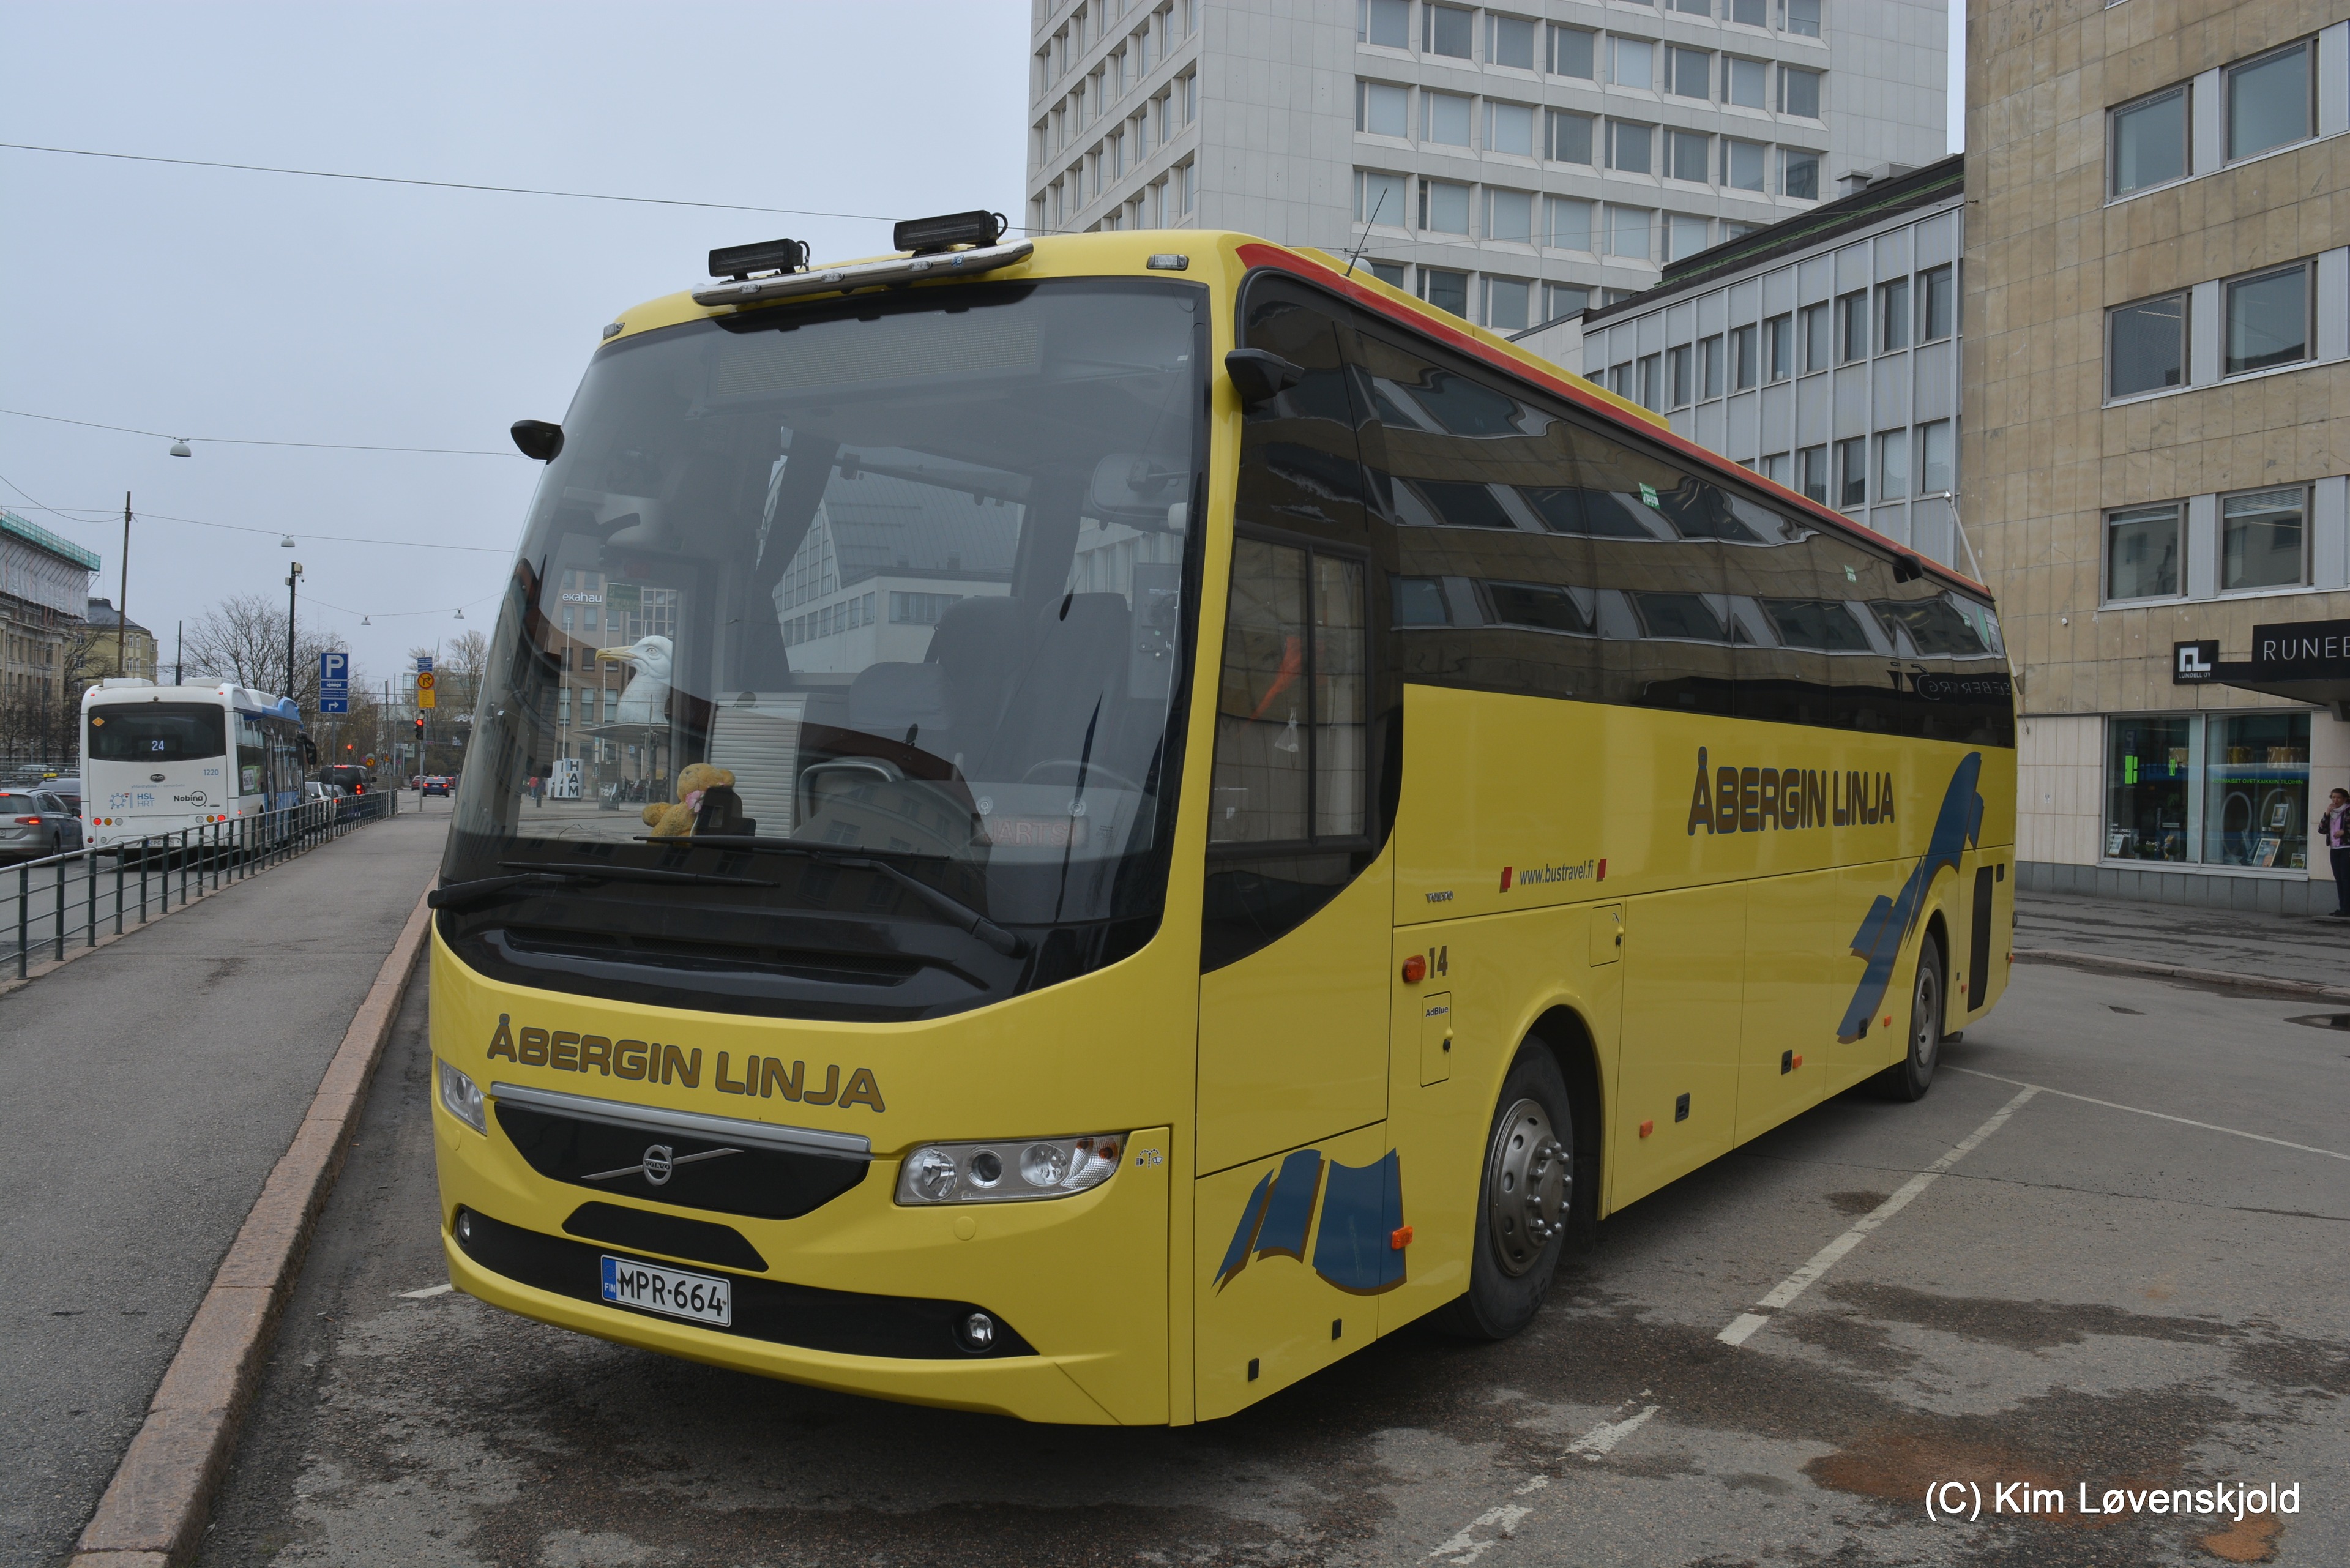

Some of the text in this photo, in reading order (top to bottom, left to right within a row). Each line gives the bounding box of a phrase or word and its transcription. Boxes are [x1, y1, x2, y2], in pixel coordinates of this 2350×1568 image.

[562, 592, 602, 602] ekahau
[326, 655, 344, 678] P
[152, 740, 165, 751] 24
[1687, 745, 1895, 836] ÅBERGIN LINJA
[1520, 859, 1594, 886] www.bustravel.fi
[1426, 890, 1453, 903] VOLVO
[1429, 945, 1448, 979] 14
[1425, 1006, 1449, 1017] AdBlue
[487, 1013, 886, 1113] ÅBERGIN LINJA
[644, 1160, 671, 1170] VOLVO
[605, 1282, 616, 1293] FIN
[617, 1267, 723, 1316] MPR-664
